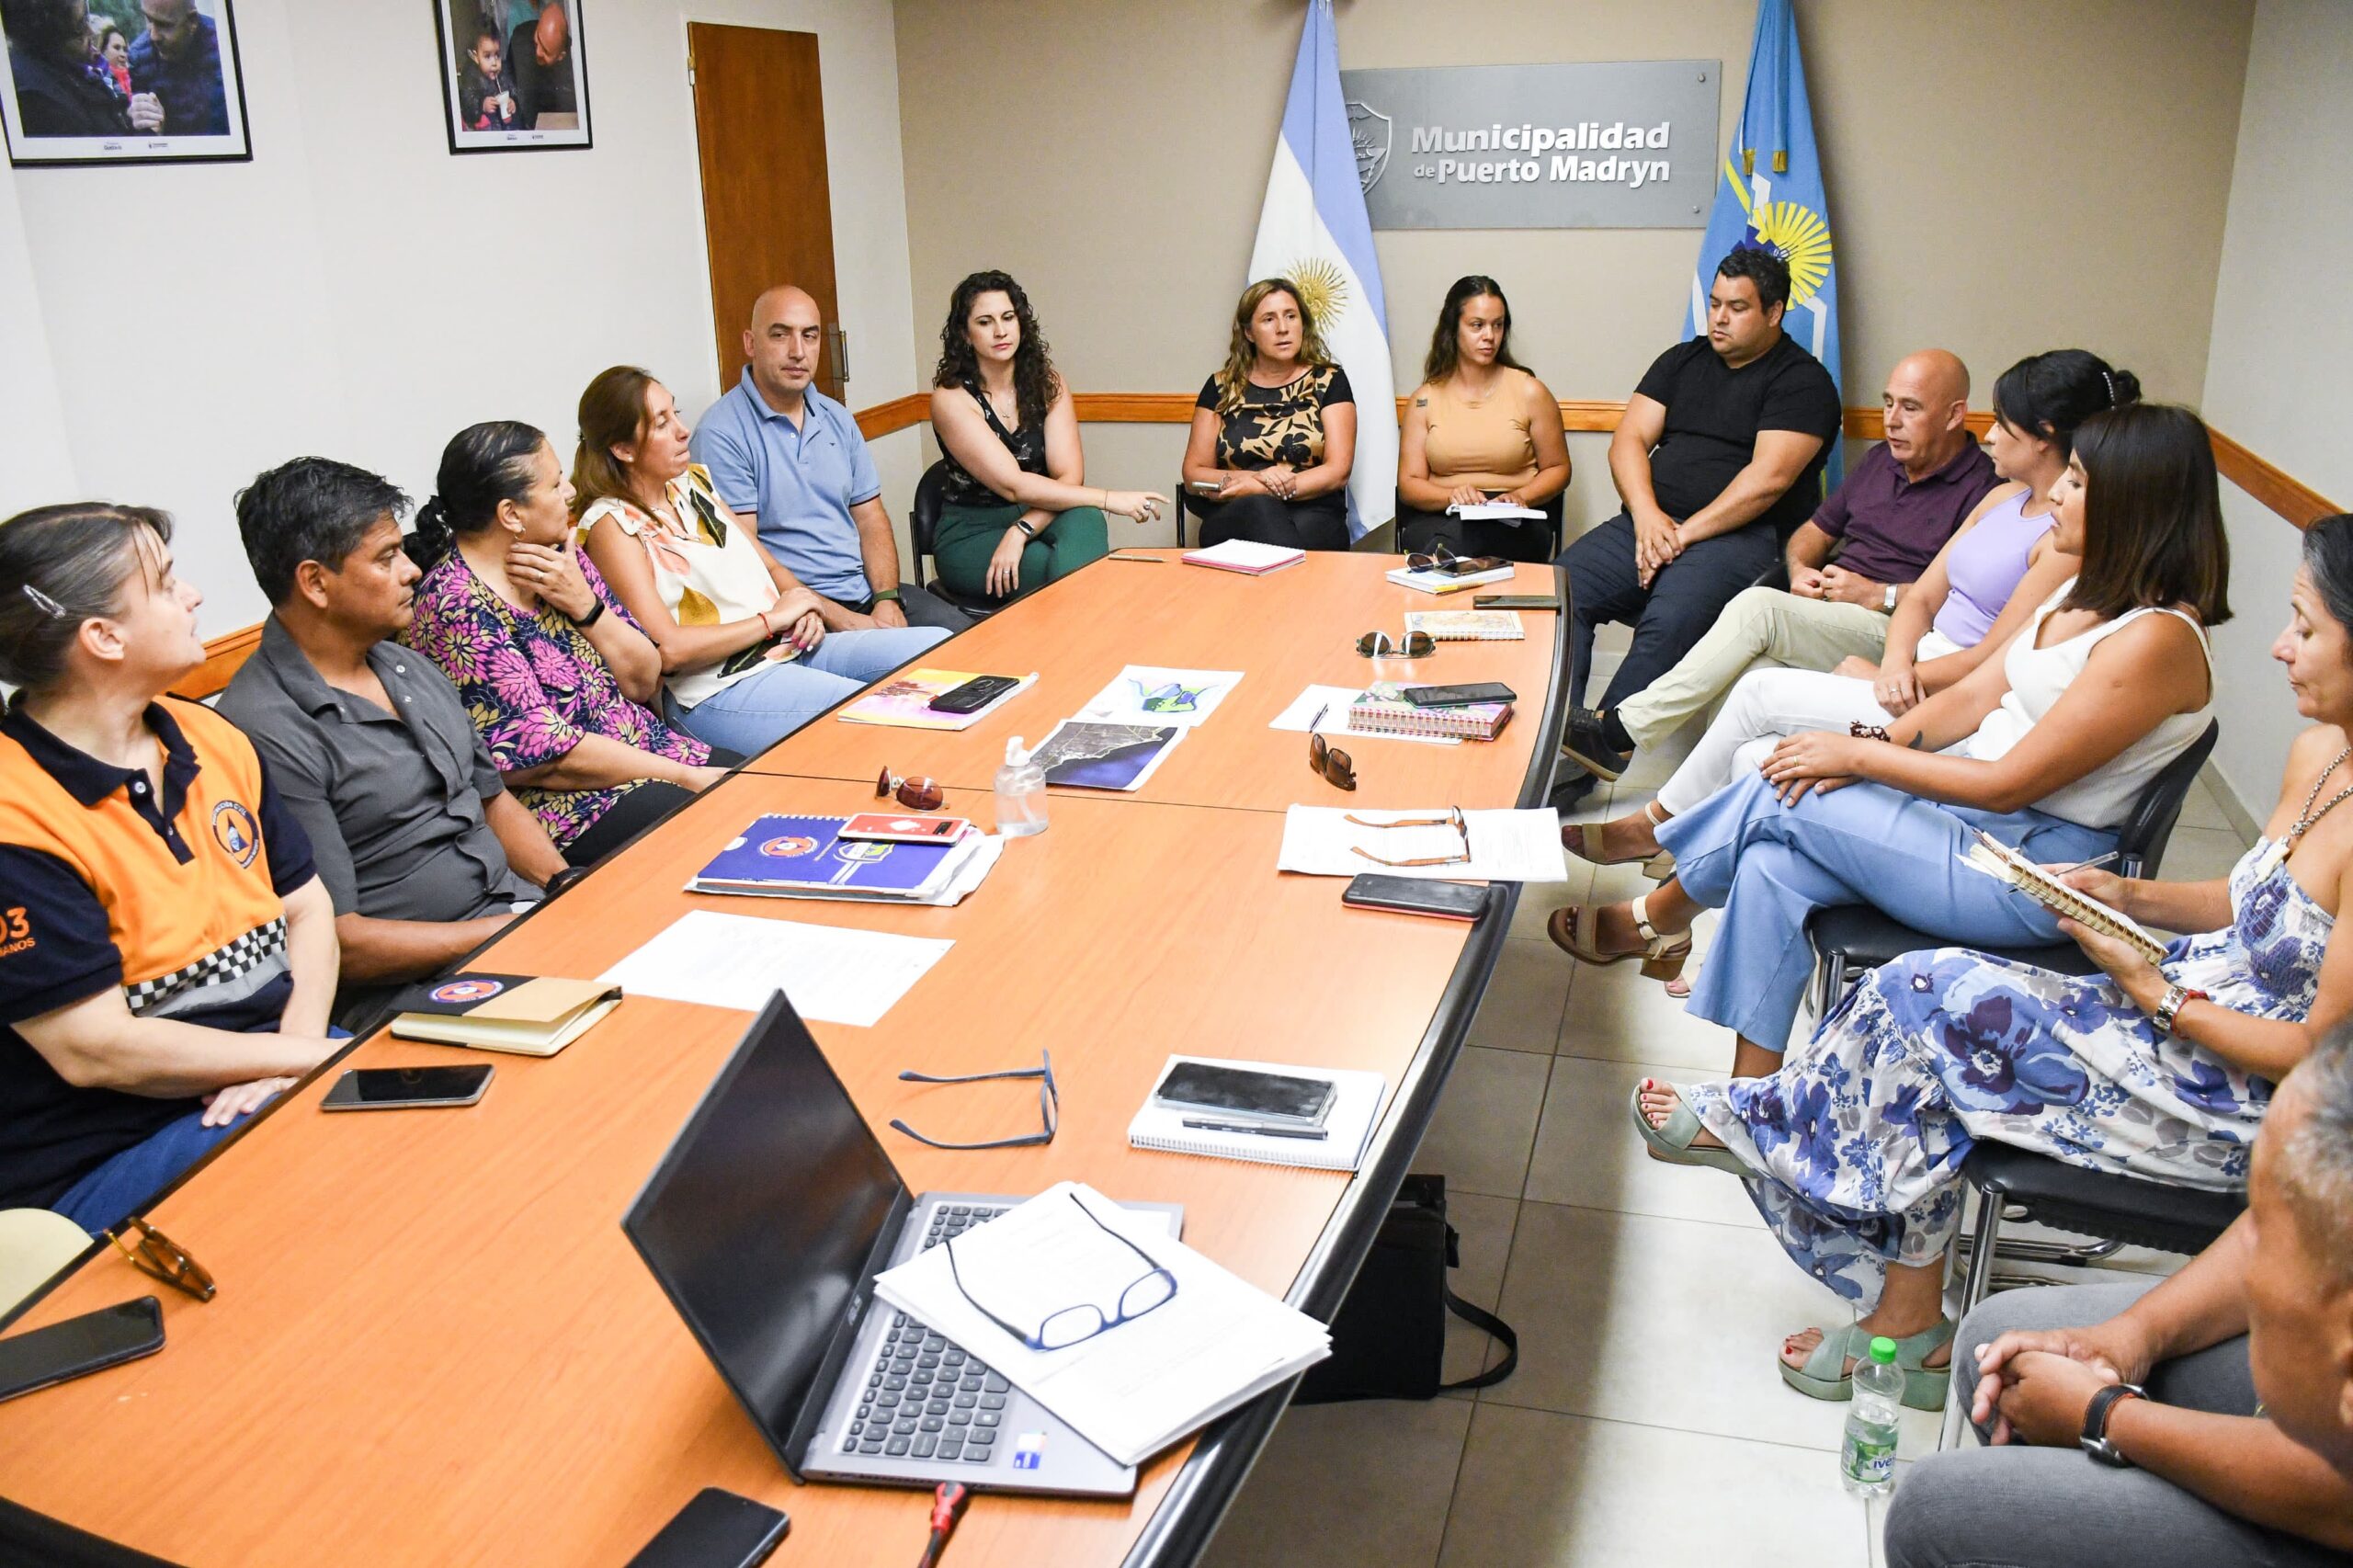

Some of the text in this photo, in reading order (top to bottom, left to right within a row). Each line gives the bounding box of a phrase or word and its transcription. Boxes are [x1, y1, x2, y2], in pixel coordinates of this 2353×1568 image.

[1411, 121, 1671, 157] Municipalidad
[1414, 155, 1671, 188] de Puerto Madryn
